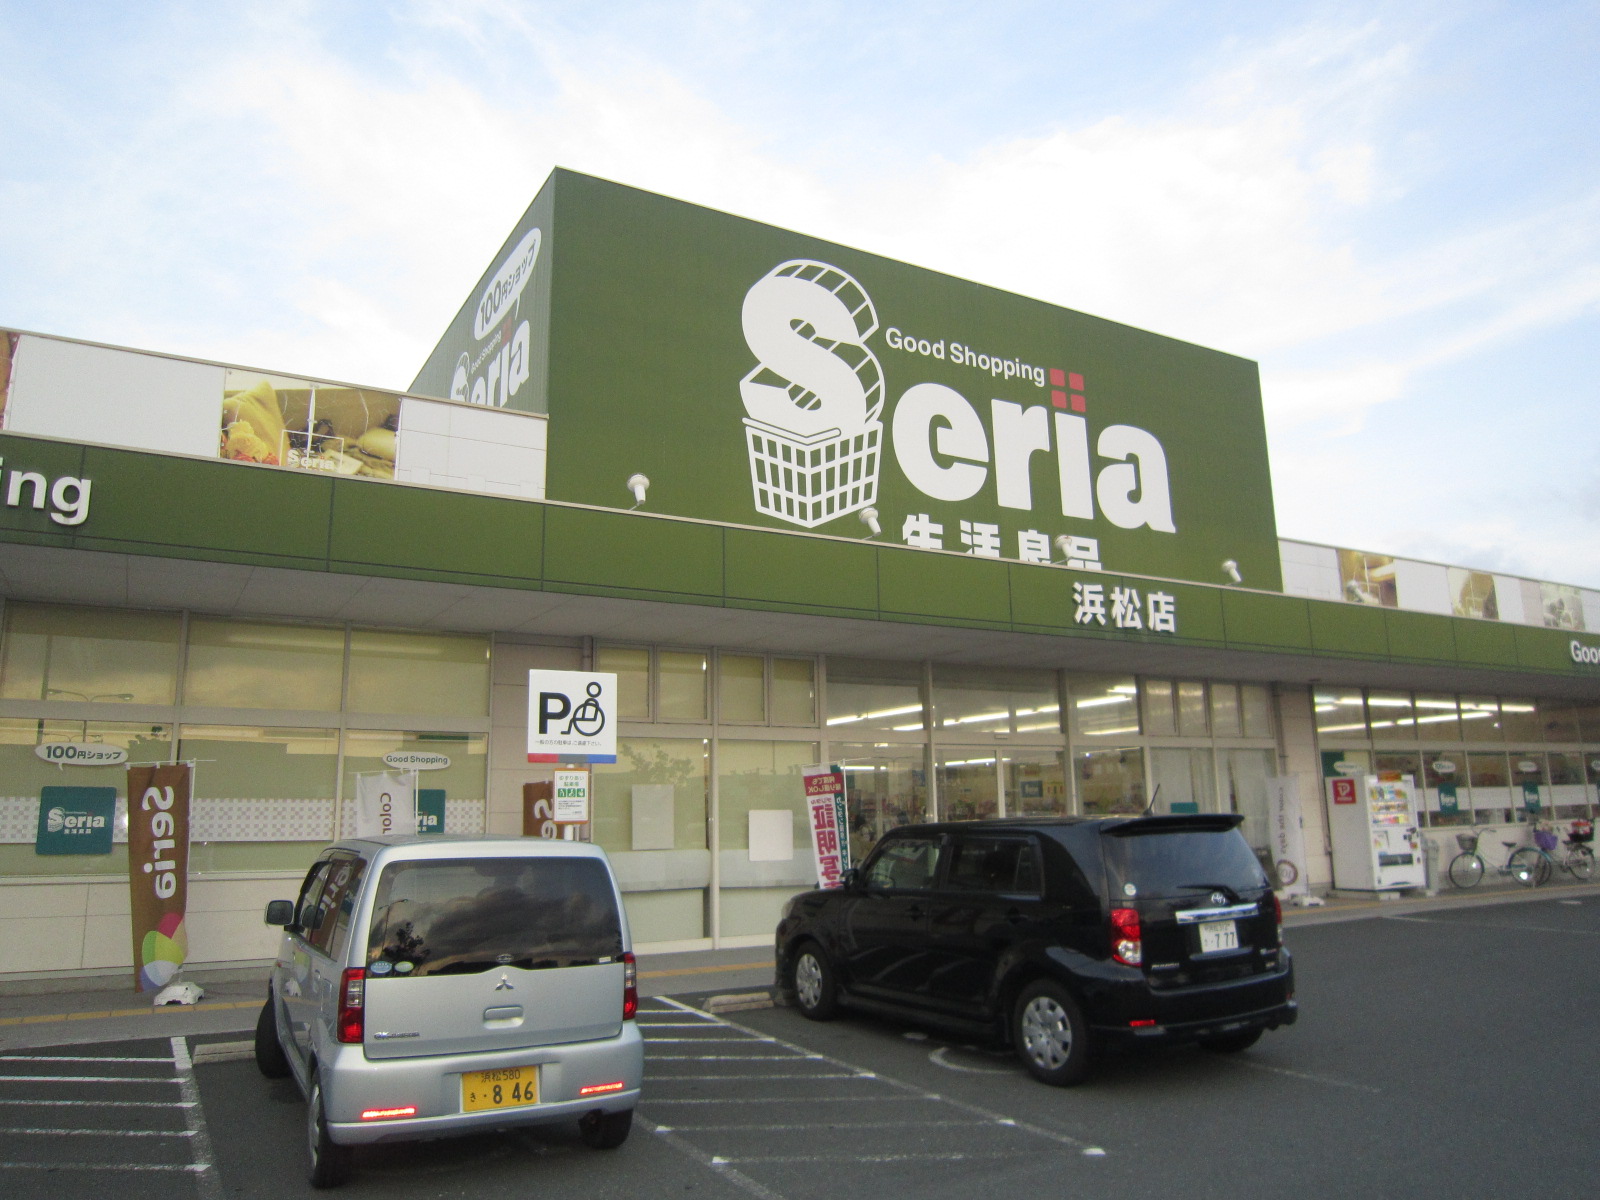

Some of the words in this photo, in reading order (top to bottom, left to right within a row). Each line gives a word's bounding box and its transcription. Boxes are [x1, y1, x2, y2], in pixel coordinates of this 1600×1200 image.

[480, 239, 537, 332] 100円ショップ
[885, 327, 945, 360] Good
[949, 342, 1045, 388] Shopping
[740, 259, 1177, 534] Seria
[0, 456, 92, 526] ng
[1072, 581, 1176, 634] 浜松店
[1570, 640, 1600, 664] Goo
[538, 692, 572, 734] P
[45, 745, 122, 761] 100円ショップ
[386, 755, 409, 763] Good
[410, 755, 448, 765] Shopping
[47, 807, 105, 832] Seria
